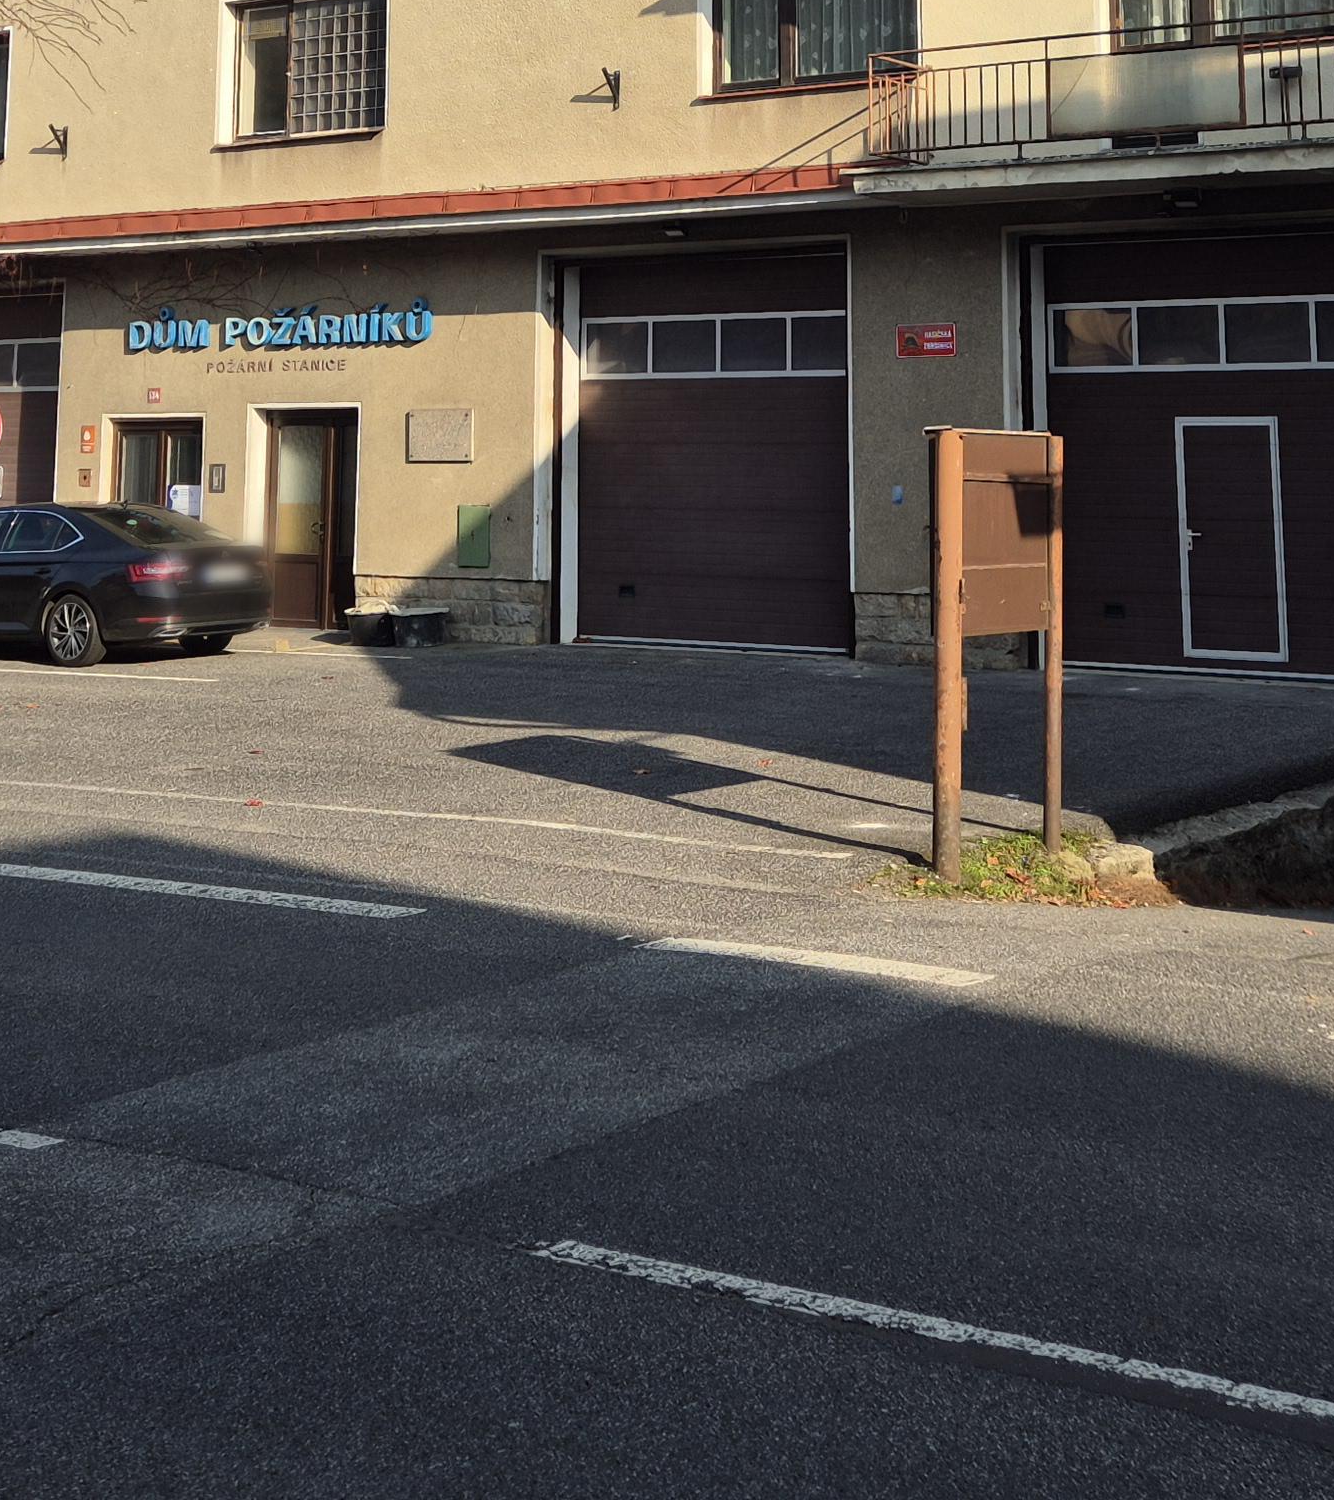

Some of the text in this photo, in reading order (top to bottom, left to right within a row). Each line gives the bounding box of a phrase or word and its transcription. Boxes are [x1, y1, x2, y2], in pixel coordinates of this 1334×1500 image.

[128, 297, 435, 350] DŮM POŽÁRNÍKŮ
[205, 357, 348, 374] POŽÁRNÍ STANICE
